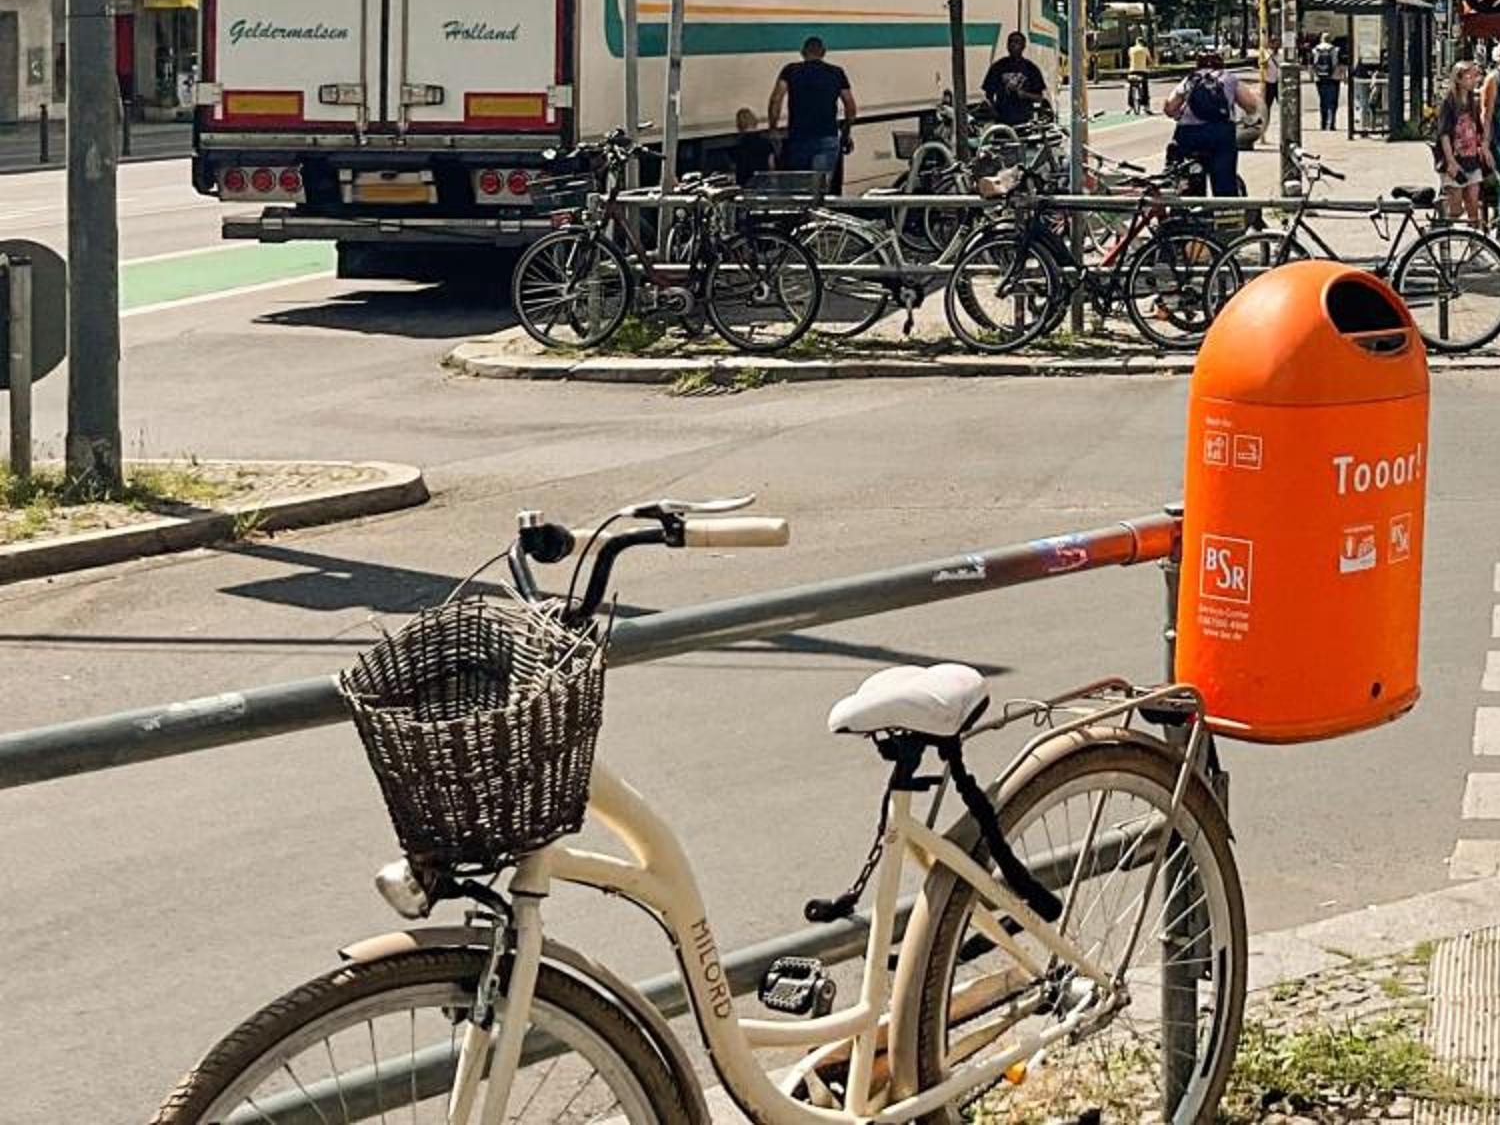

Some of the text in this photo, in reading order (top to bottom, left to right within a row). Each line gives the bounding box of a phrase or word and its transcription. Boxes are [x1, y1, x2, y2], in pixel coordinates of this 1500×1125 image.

[229, 19, 350, 44] Geldermalsen
[443, 20, 519, 41] Holland
[1333, 443, 1422, 496] Tooor!
[1205, 546, 1246, 590] BSR
[691, 920, 732, 1019] MILORD
